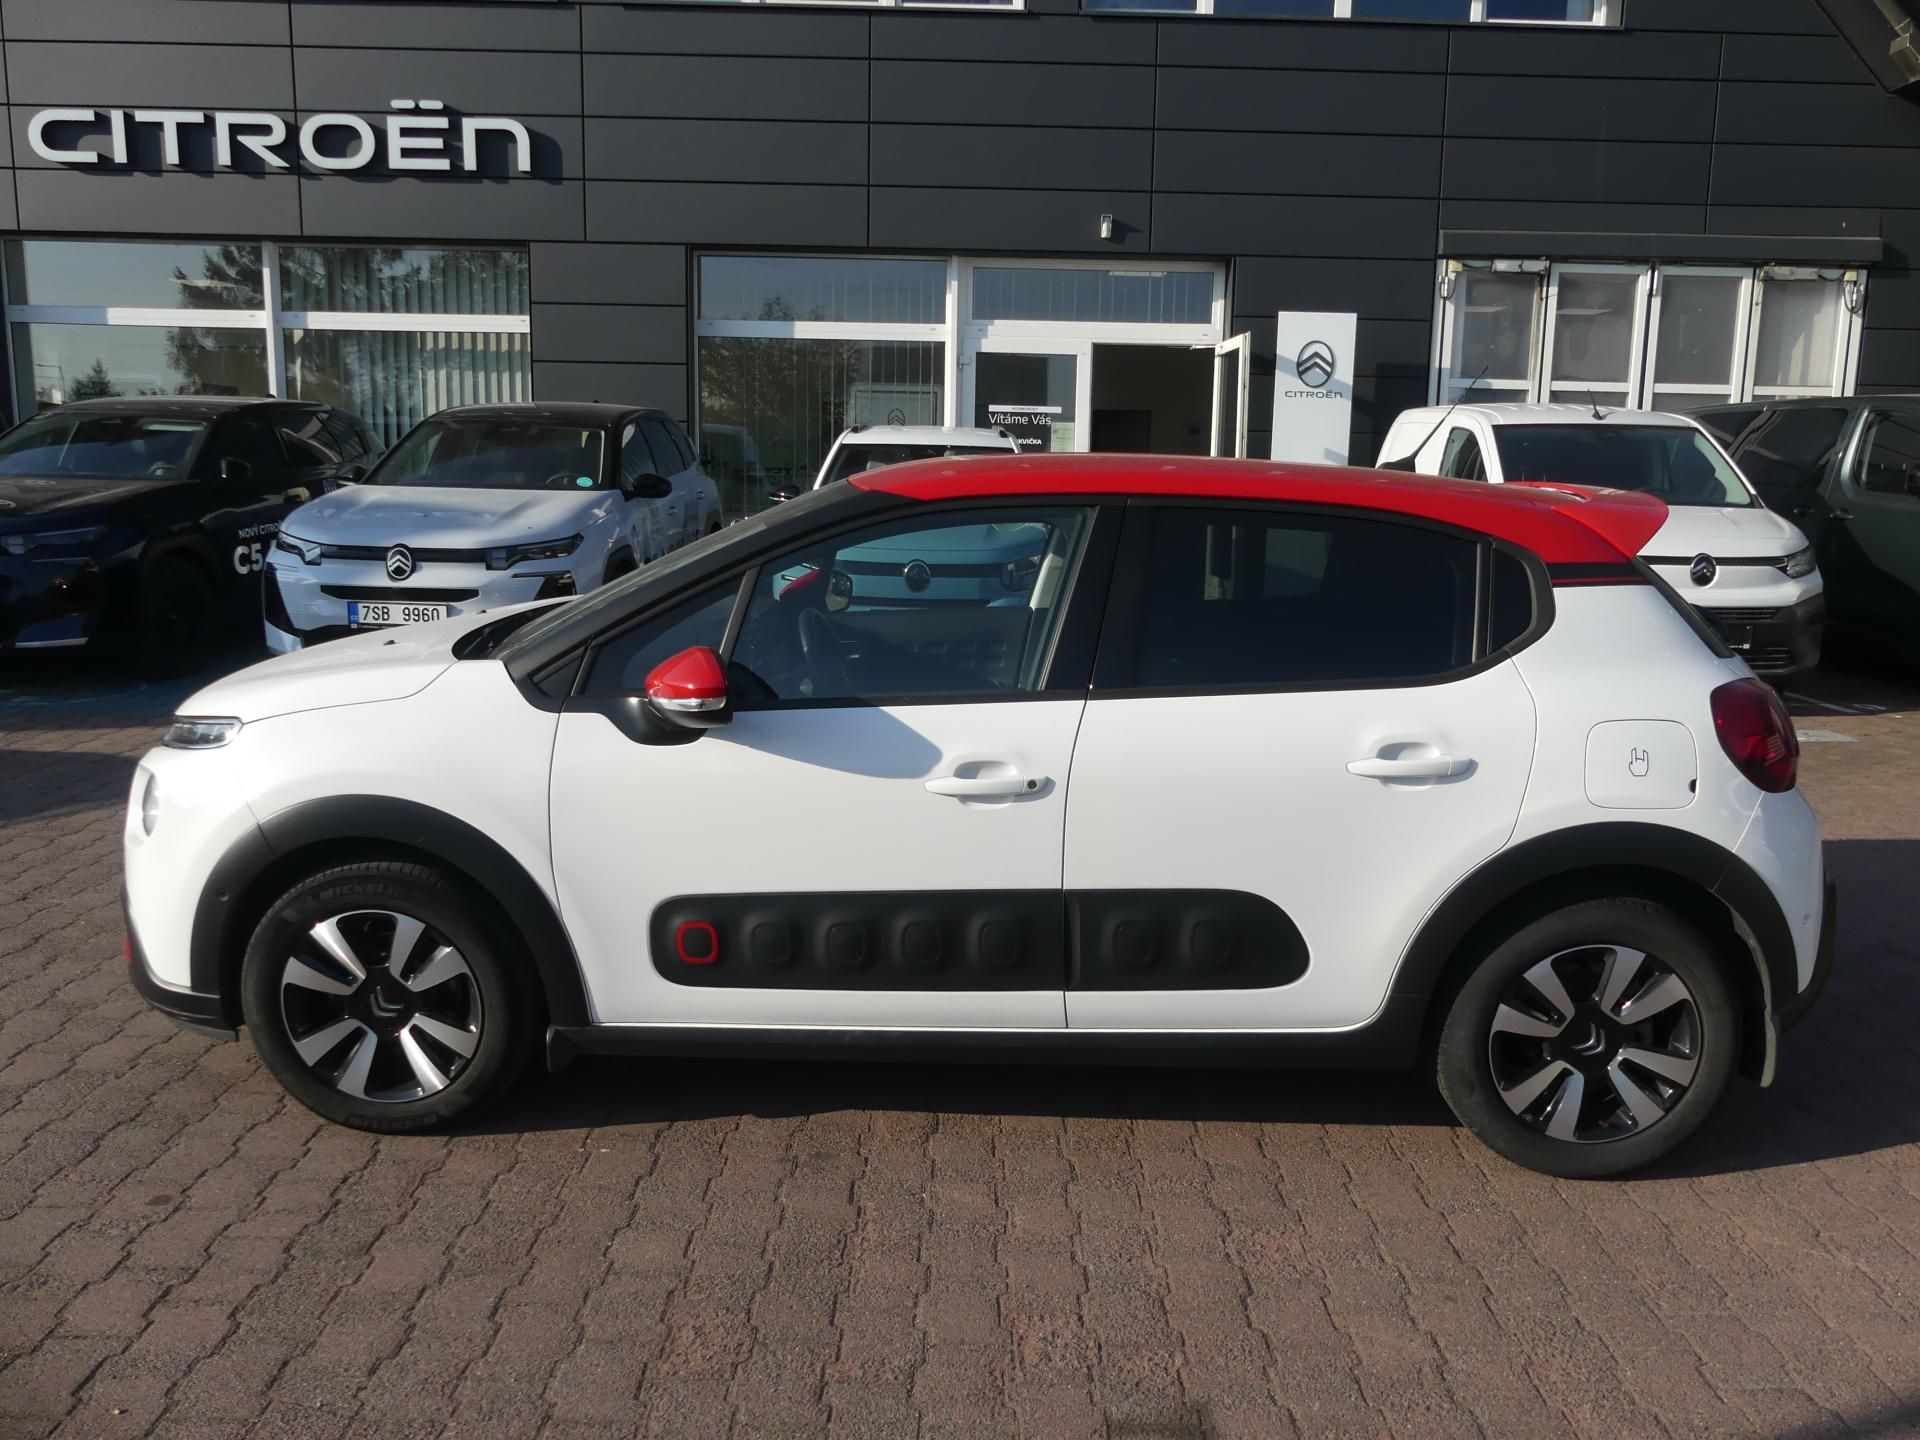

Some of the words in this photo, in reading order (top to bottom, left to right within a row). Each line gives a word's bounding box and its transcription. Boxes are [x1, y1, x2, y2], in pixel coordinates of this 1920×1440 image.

[28, 99, 532, 173] CITROËN
[1284, 389, 1343, 399] CITROËN
[988, 412, 1029, 425] Vítáme
[1031, 413, 1052, 425] Vás
[238, 524, 259, 540] NOVÝ
[259, 520, 282, 535] CITRO
[233, 543, 264, 575] C5
[362, 605, 391, 621] 7SB
[402, 606, 440, 622] 9960
